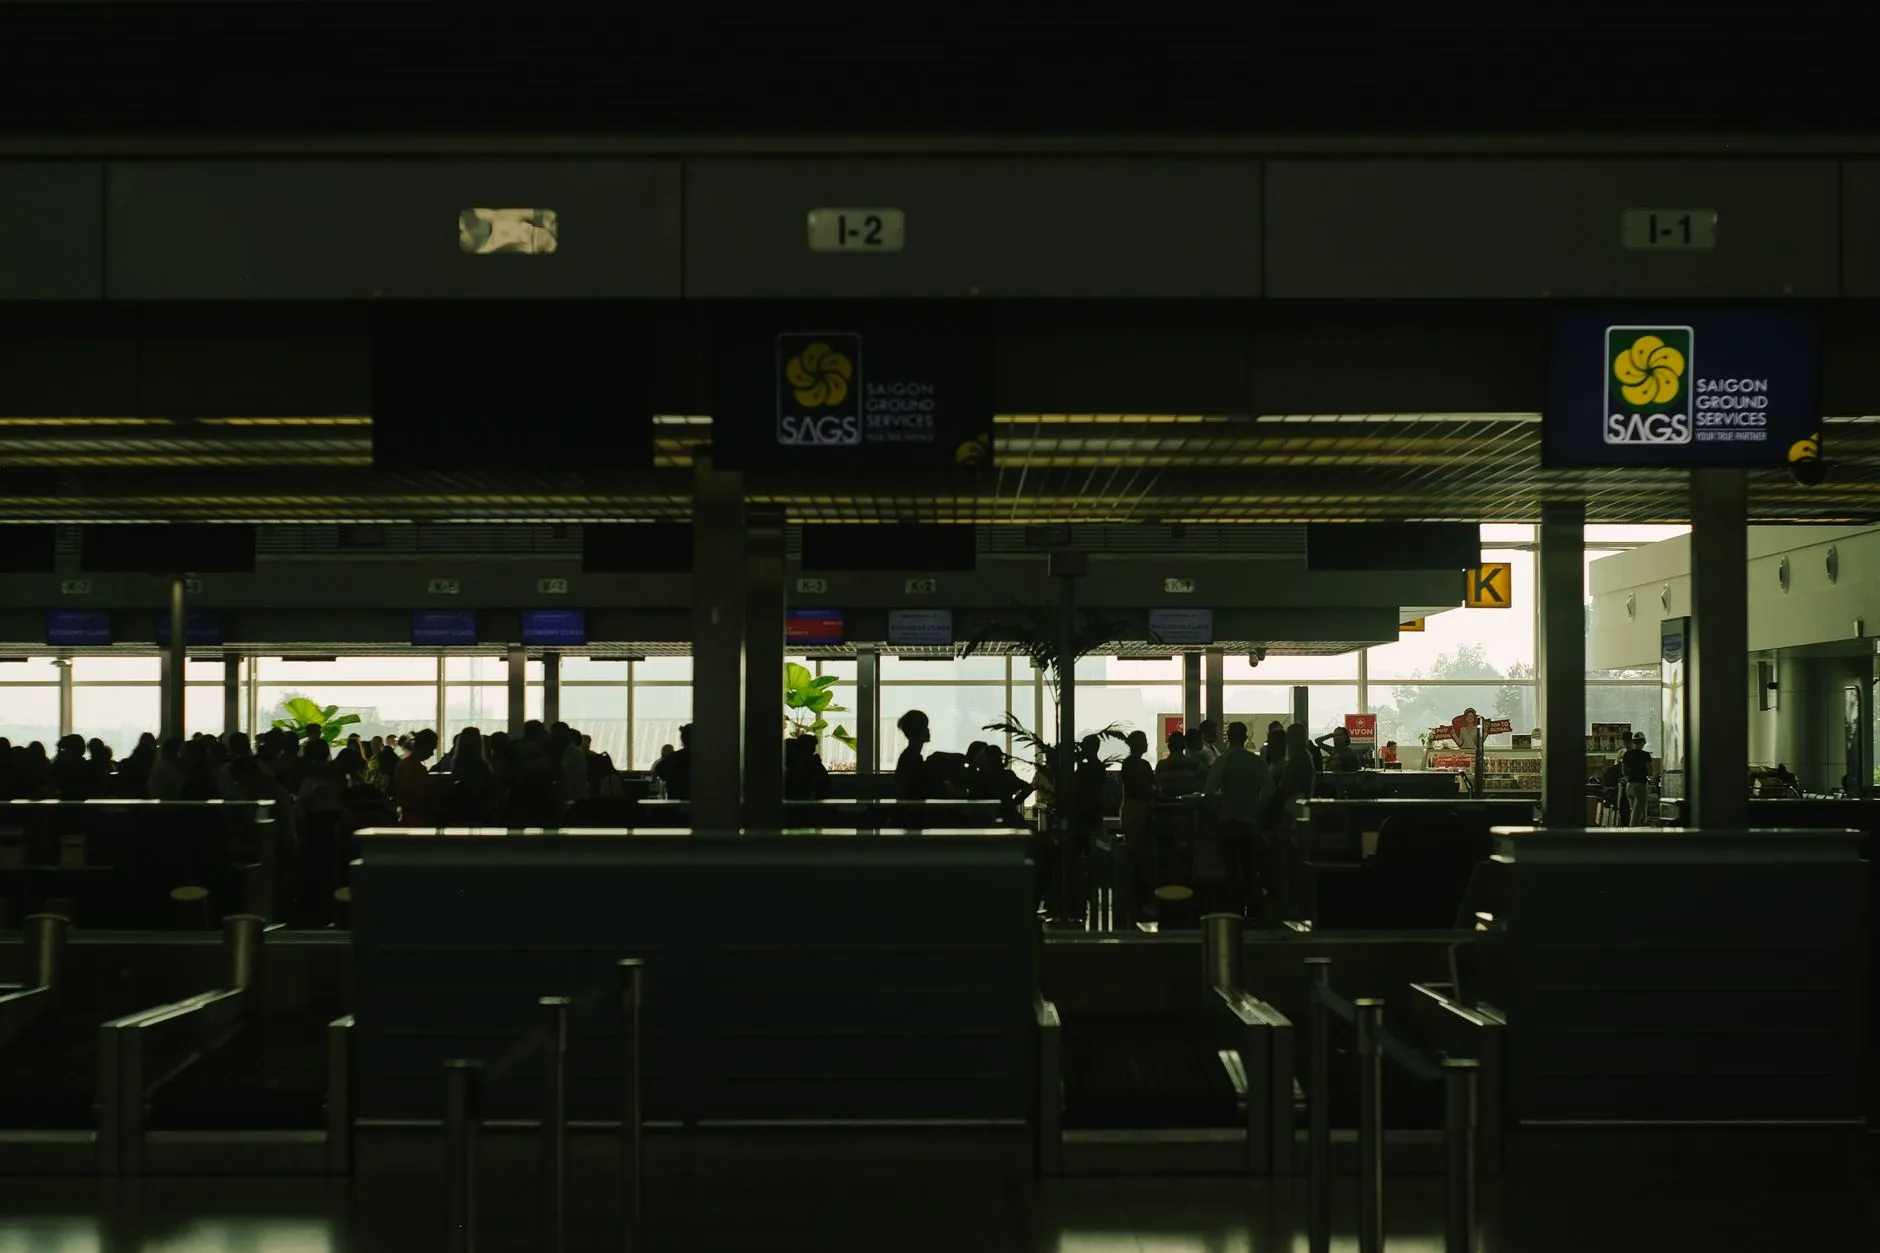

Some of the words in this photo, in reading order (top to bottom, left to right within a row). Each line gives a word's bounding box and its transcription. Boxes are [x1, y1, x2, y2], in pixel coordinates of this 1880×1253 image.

[838, 214, 882, 245] I-2
[1650, 214, 1691, 244] I-1
[866, 381, 935, 396] SAIGON
[1696, 378, 1768, 393] SAIGON
[866, 397, 935, 412] GROUND
[1695, 395, 1769, 409] GROUND
[866, 413, 935, 428] SERVICES
[1696, 411, 1767, 426] SERVICES
[781, 415, 858, 444] SAGS
[1608, 413, 1688, 442] SAGS
[1736, 431, 1768, 441] PARTNER
[802, 580, 823, 592] K-3
[911, 580, 932, 592] K-2
[1475, 568, 1504, 602] K
